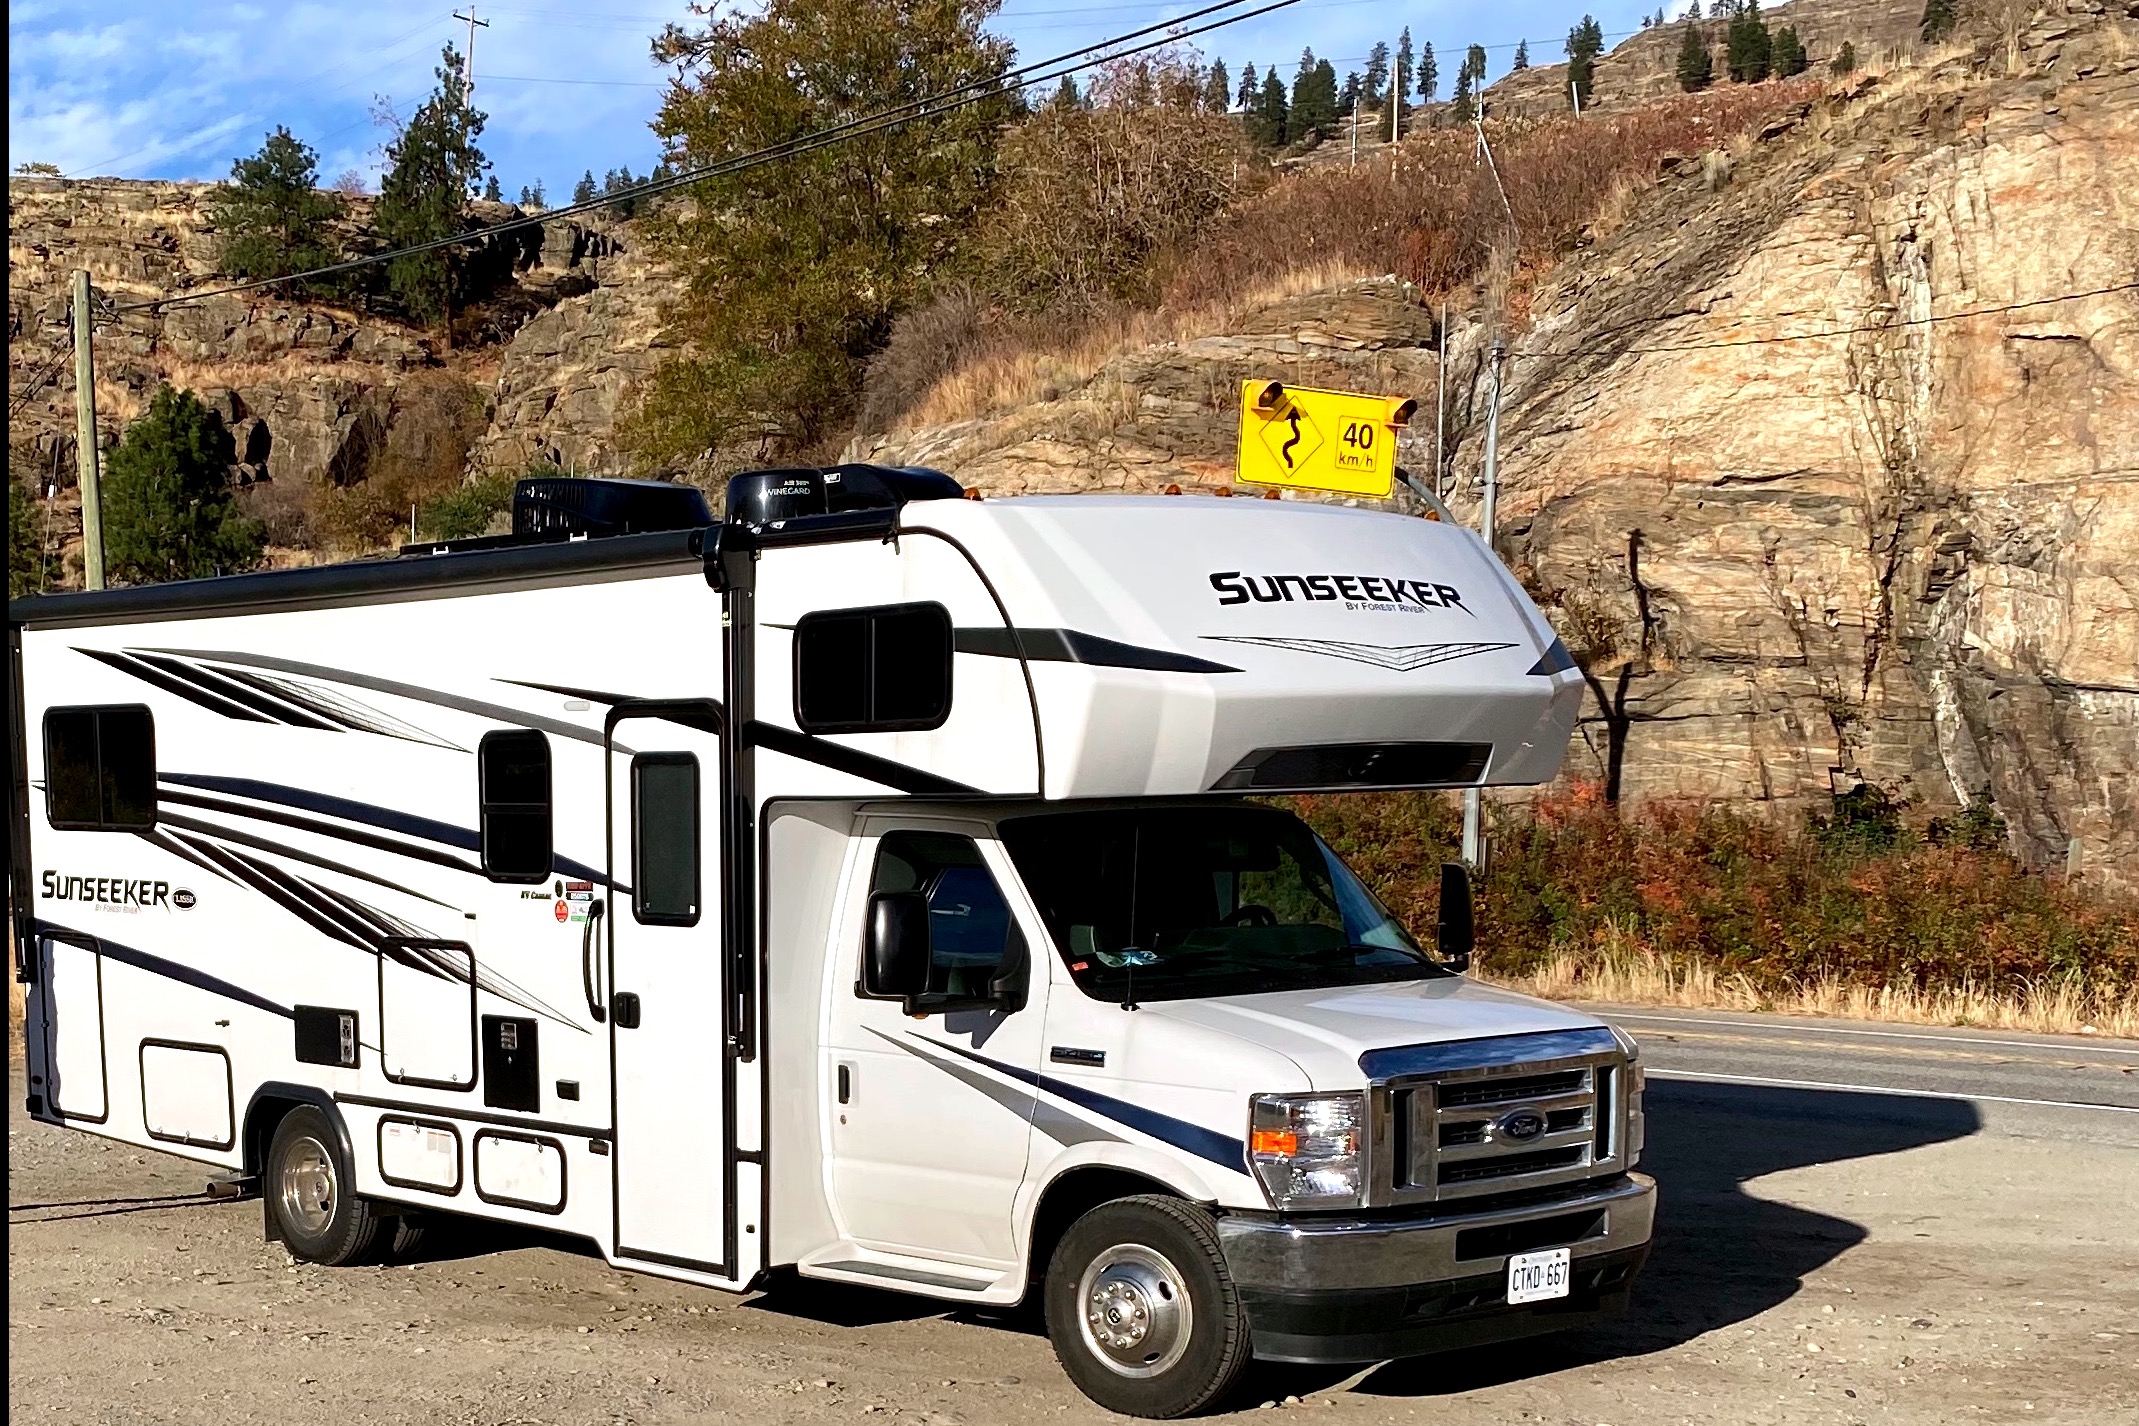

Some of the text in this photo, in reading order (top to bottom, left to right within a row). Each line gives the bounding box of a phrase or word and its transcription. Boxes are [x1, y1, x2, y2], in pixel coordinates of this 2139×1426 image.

[1342, 422, 1374, 450] 40
[1338, 451, 1374, 469] km/h
[767, 487, 811, 496] WINEGARD
[1209, 571, 1478, 619] SUNSEEKER
[1345, 601, 1425, 614] BY FOREST RIVER
[41, 869, 171, 915] SUNSEEKER
[1512, 1117, 1538, 1136] Ford
[1512, 1261, 1568, 1291] CTKD 667
